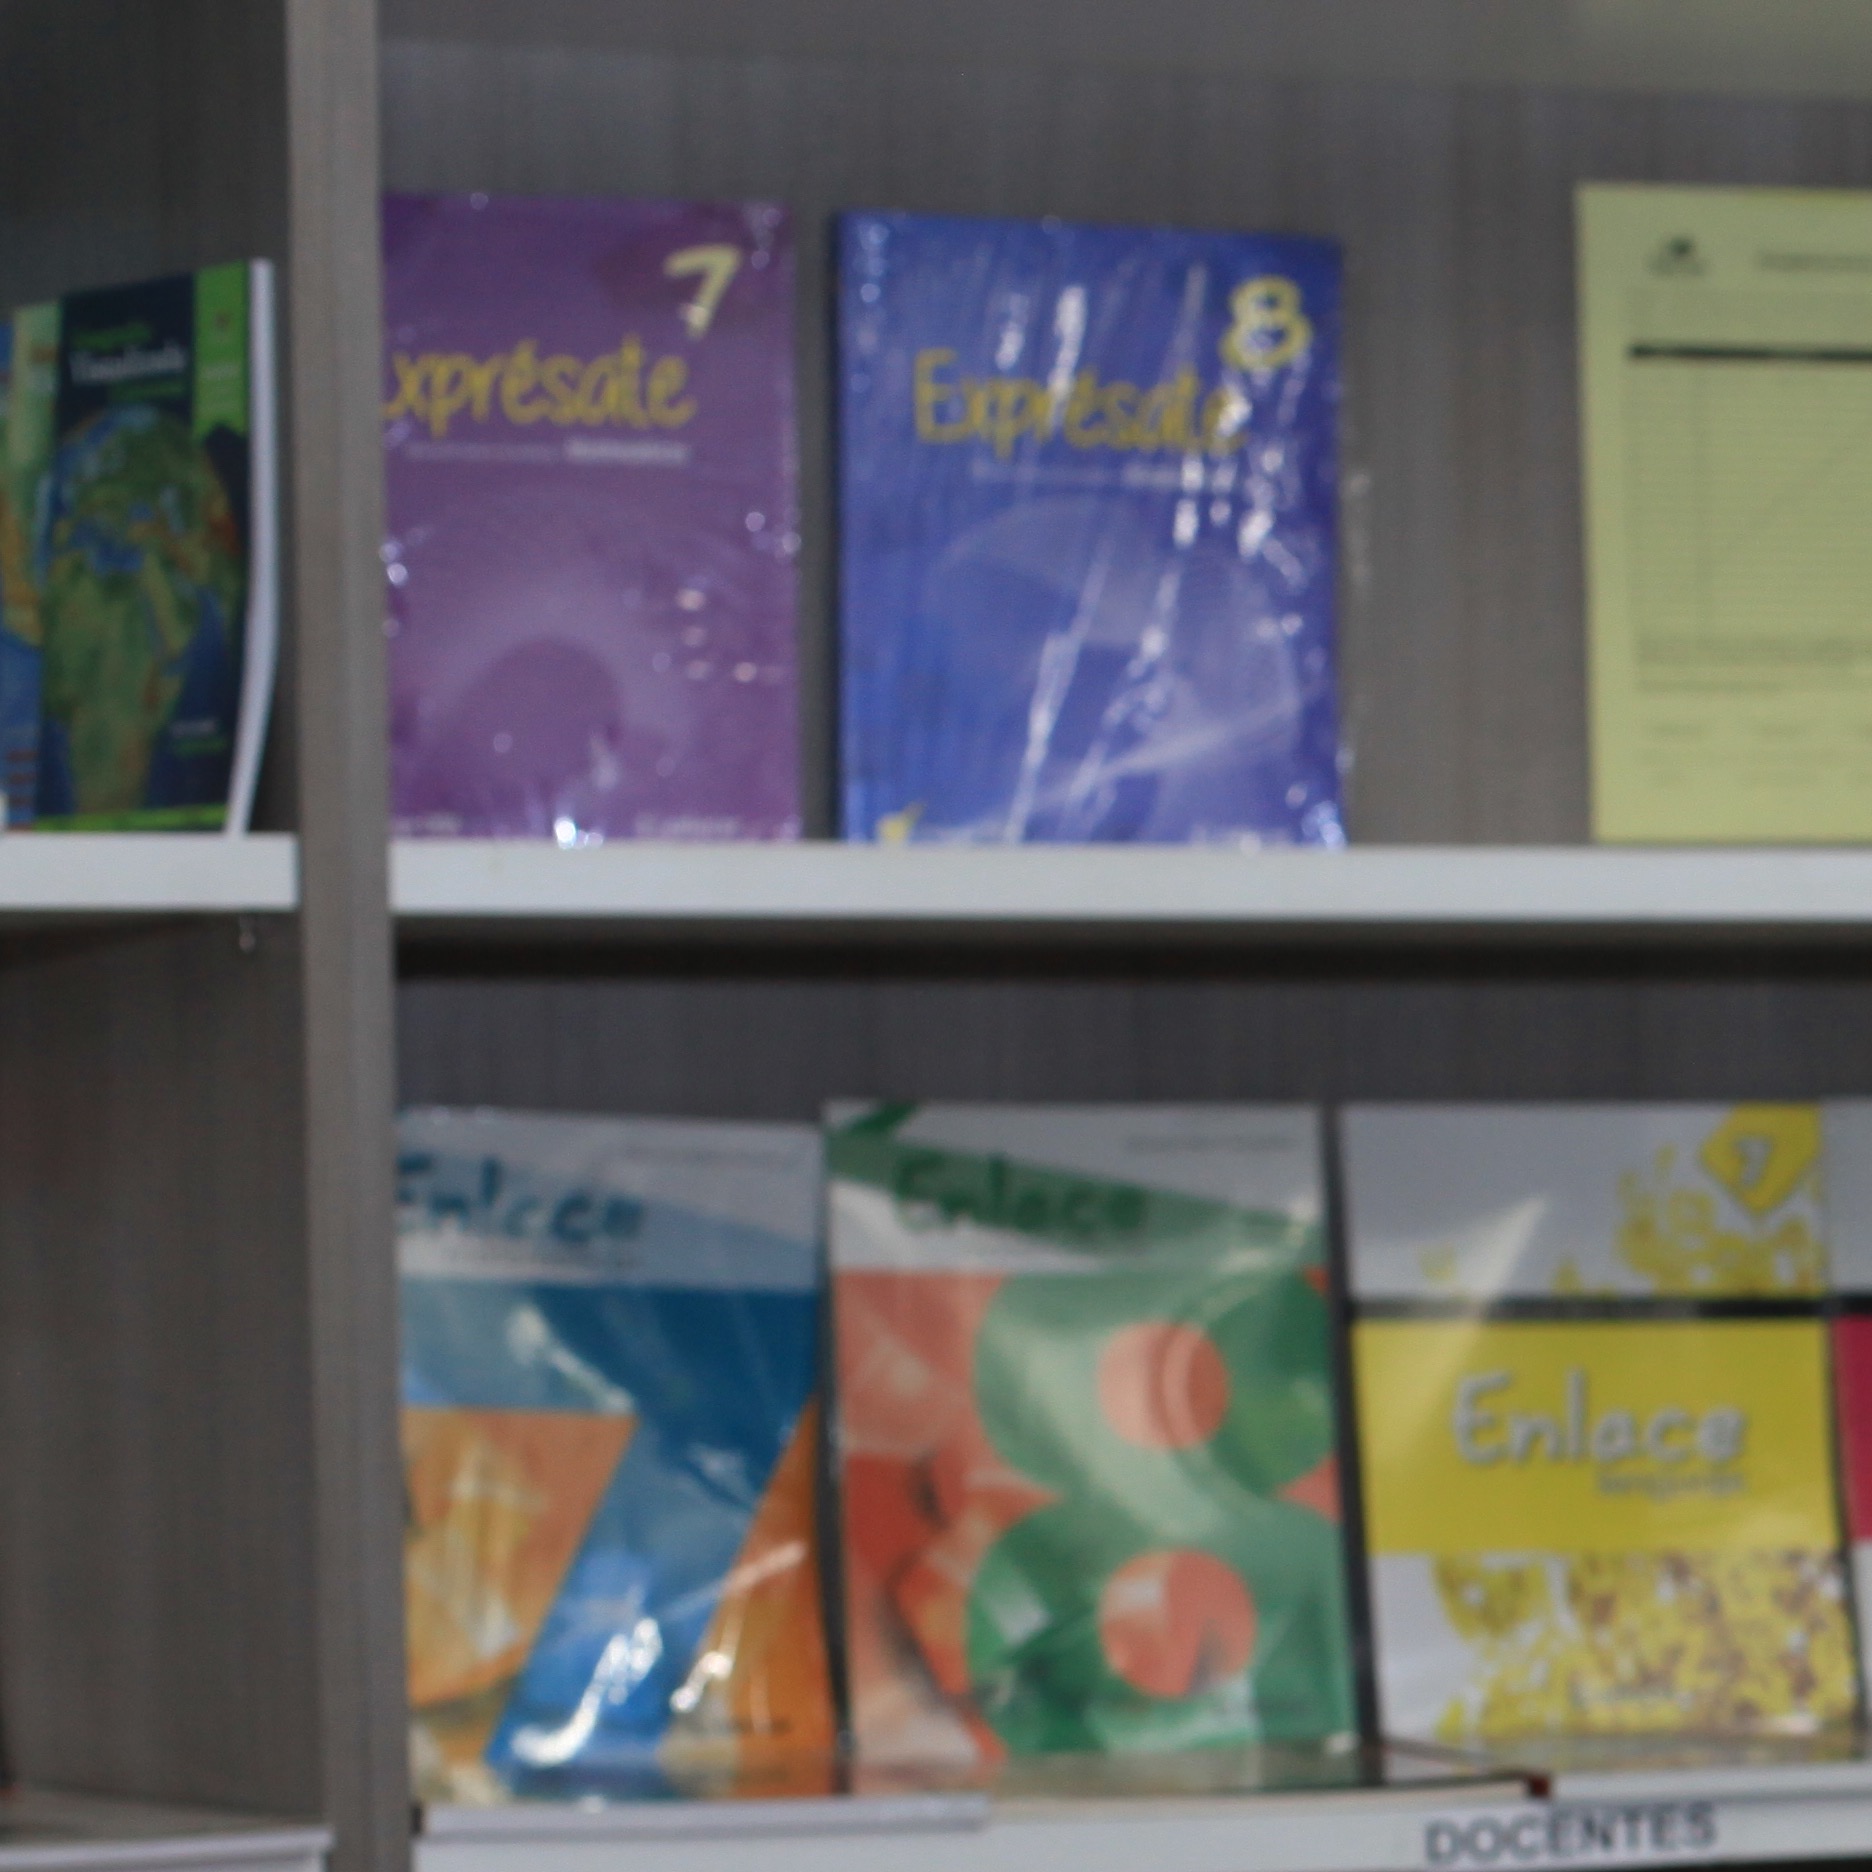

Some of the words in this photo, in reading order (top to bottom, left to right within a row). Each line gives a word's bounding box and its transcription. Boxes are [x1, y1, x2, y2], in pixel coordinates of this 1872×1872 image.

[662, 242, 742, 340] 7
[1219, 276, 1314, 372] 8
[386, 332, 700, 440] xprésate
[1735, 1134, 1772, 1190] 7
[1449, 1368, 1750, 1470] Enlace
[1422, 1800, 1720, 1870] DOCENTES
